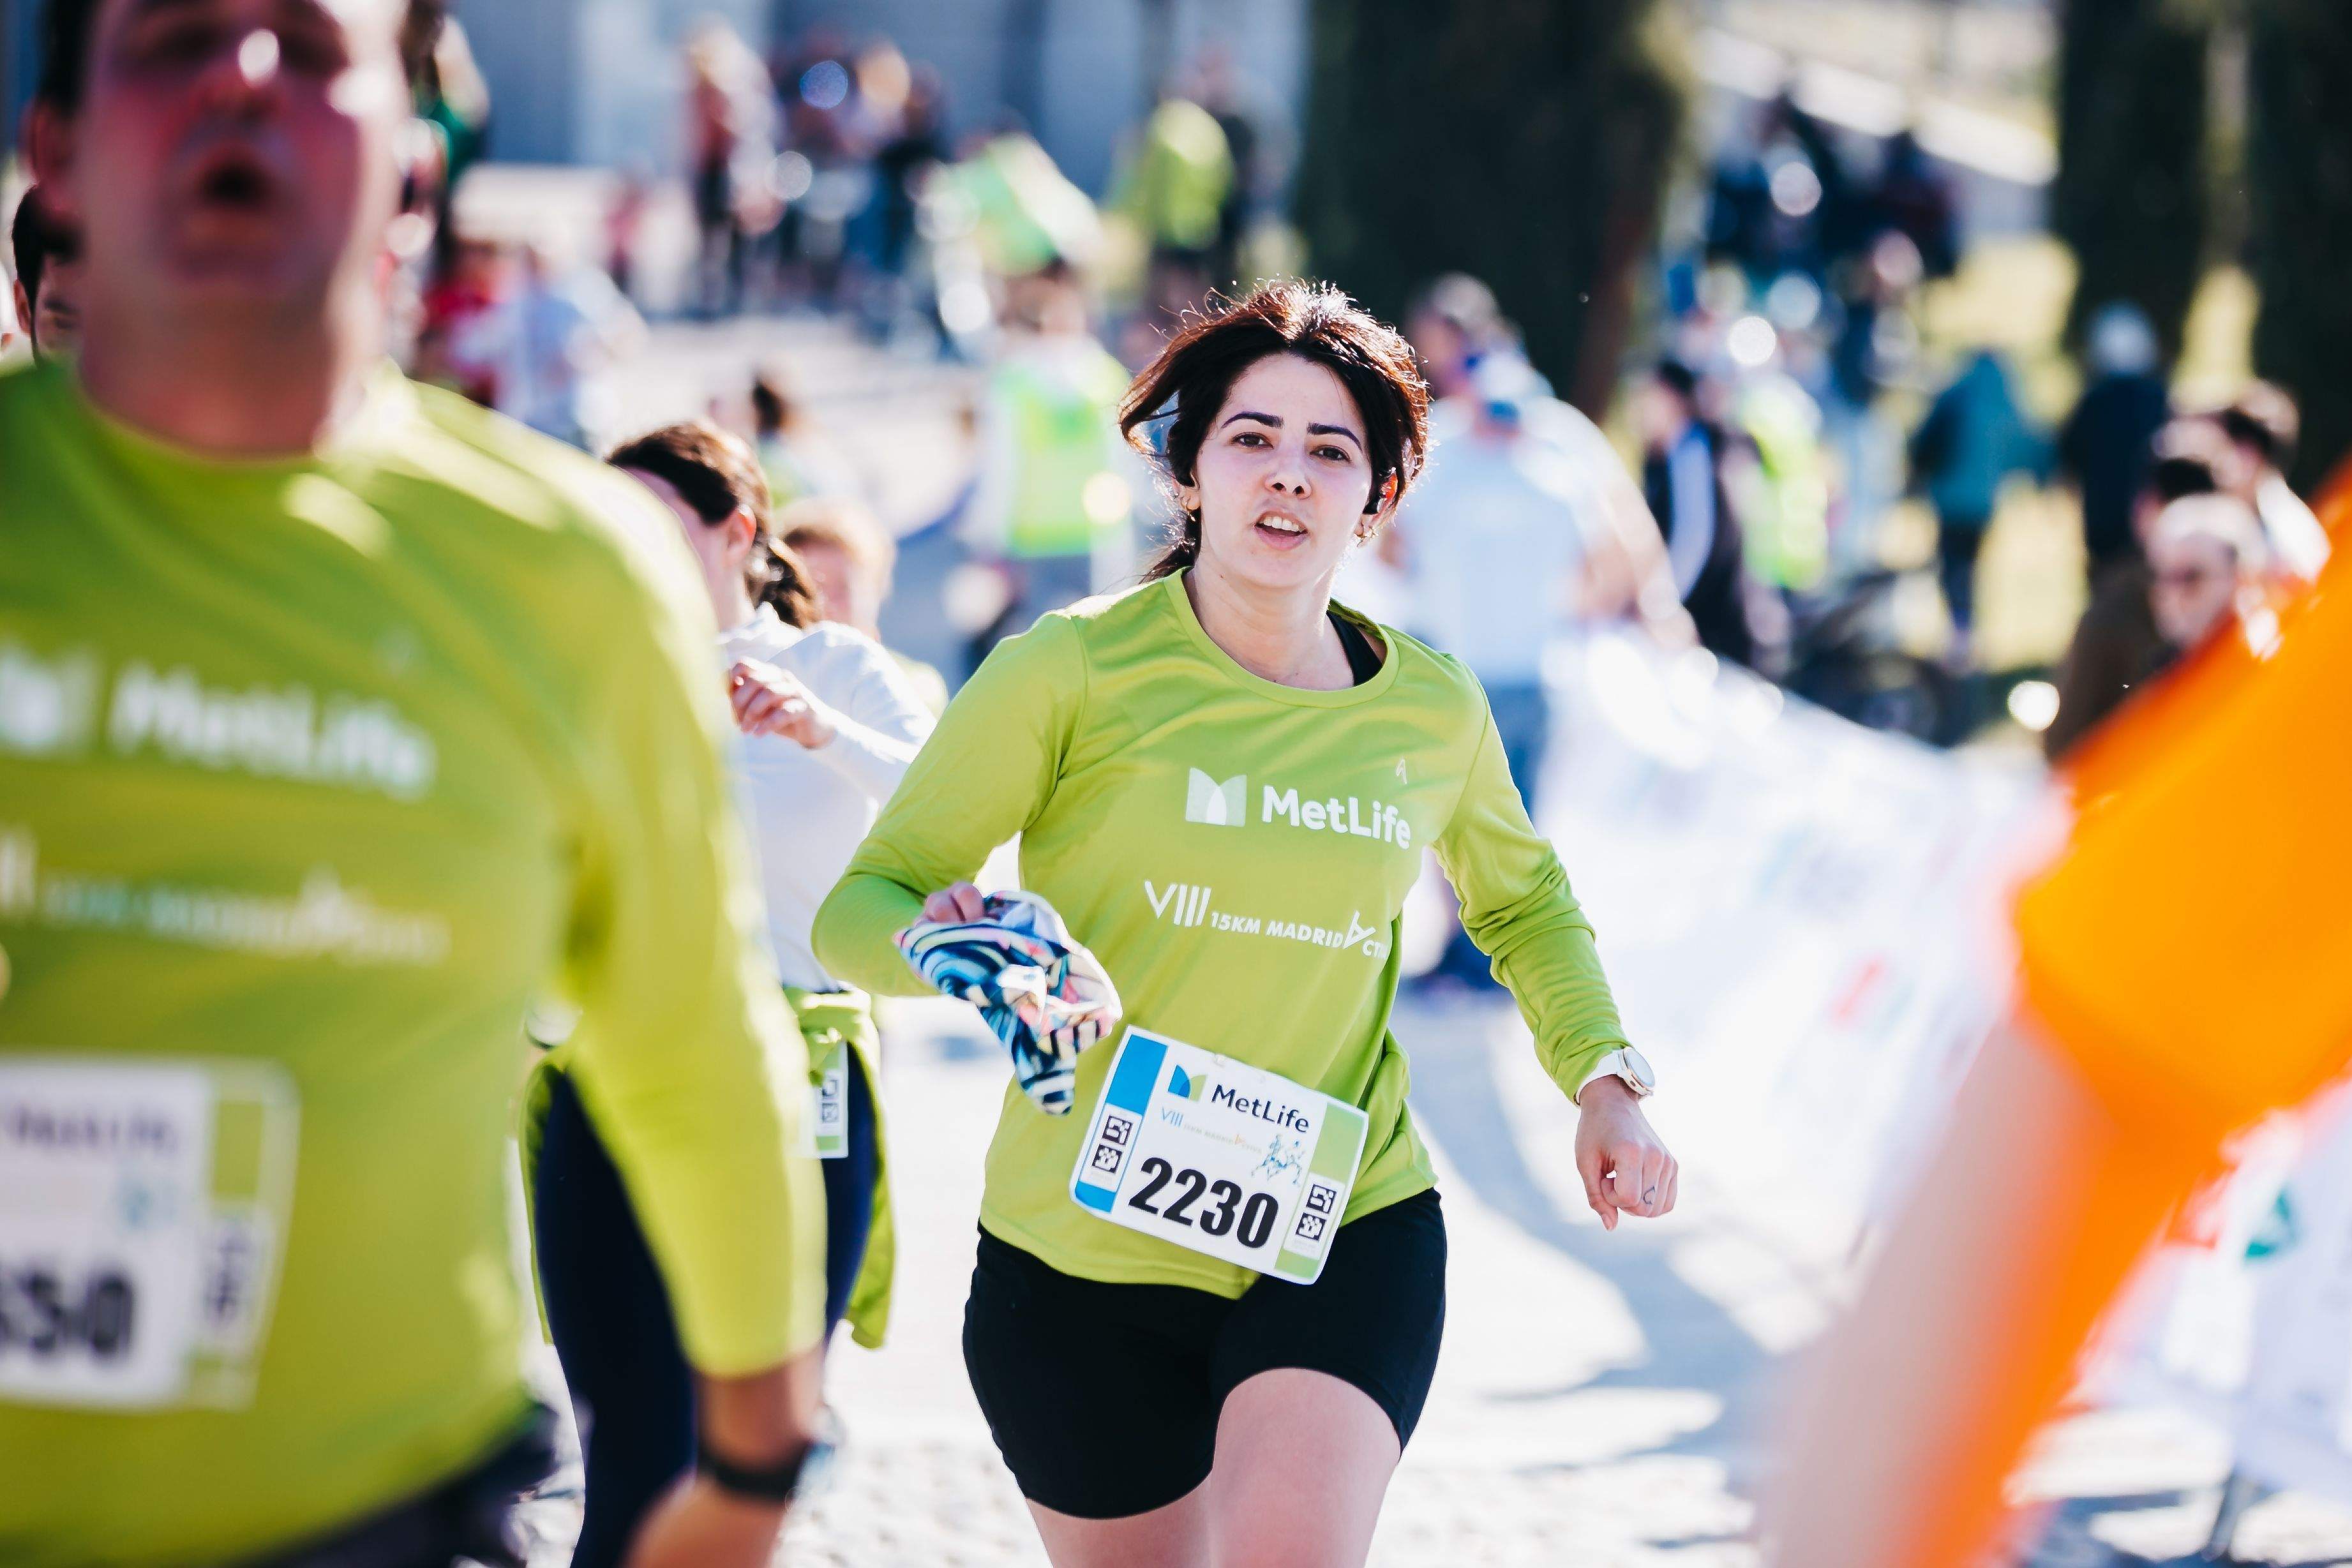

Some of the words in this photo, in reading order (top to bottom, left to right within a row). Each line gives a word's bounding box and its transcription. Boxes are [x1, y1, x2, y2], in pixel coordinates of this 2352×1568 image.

[1261, 785, 1411, 849] MetLife
[1144, 879, 1212, 927] VIII
[1210, 911, 1261, 935] 15KM
[1265, 920, 1344, 949] MADRID
[1211, 1084, 1310, 1134] MetLife
[1128, 1156, 1279, 1249] 2230
